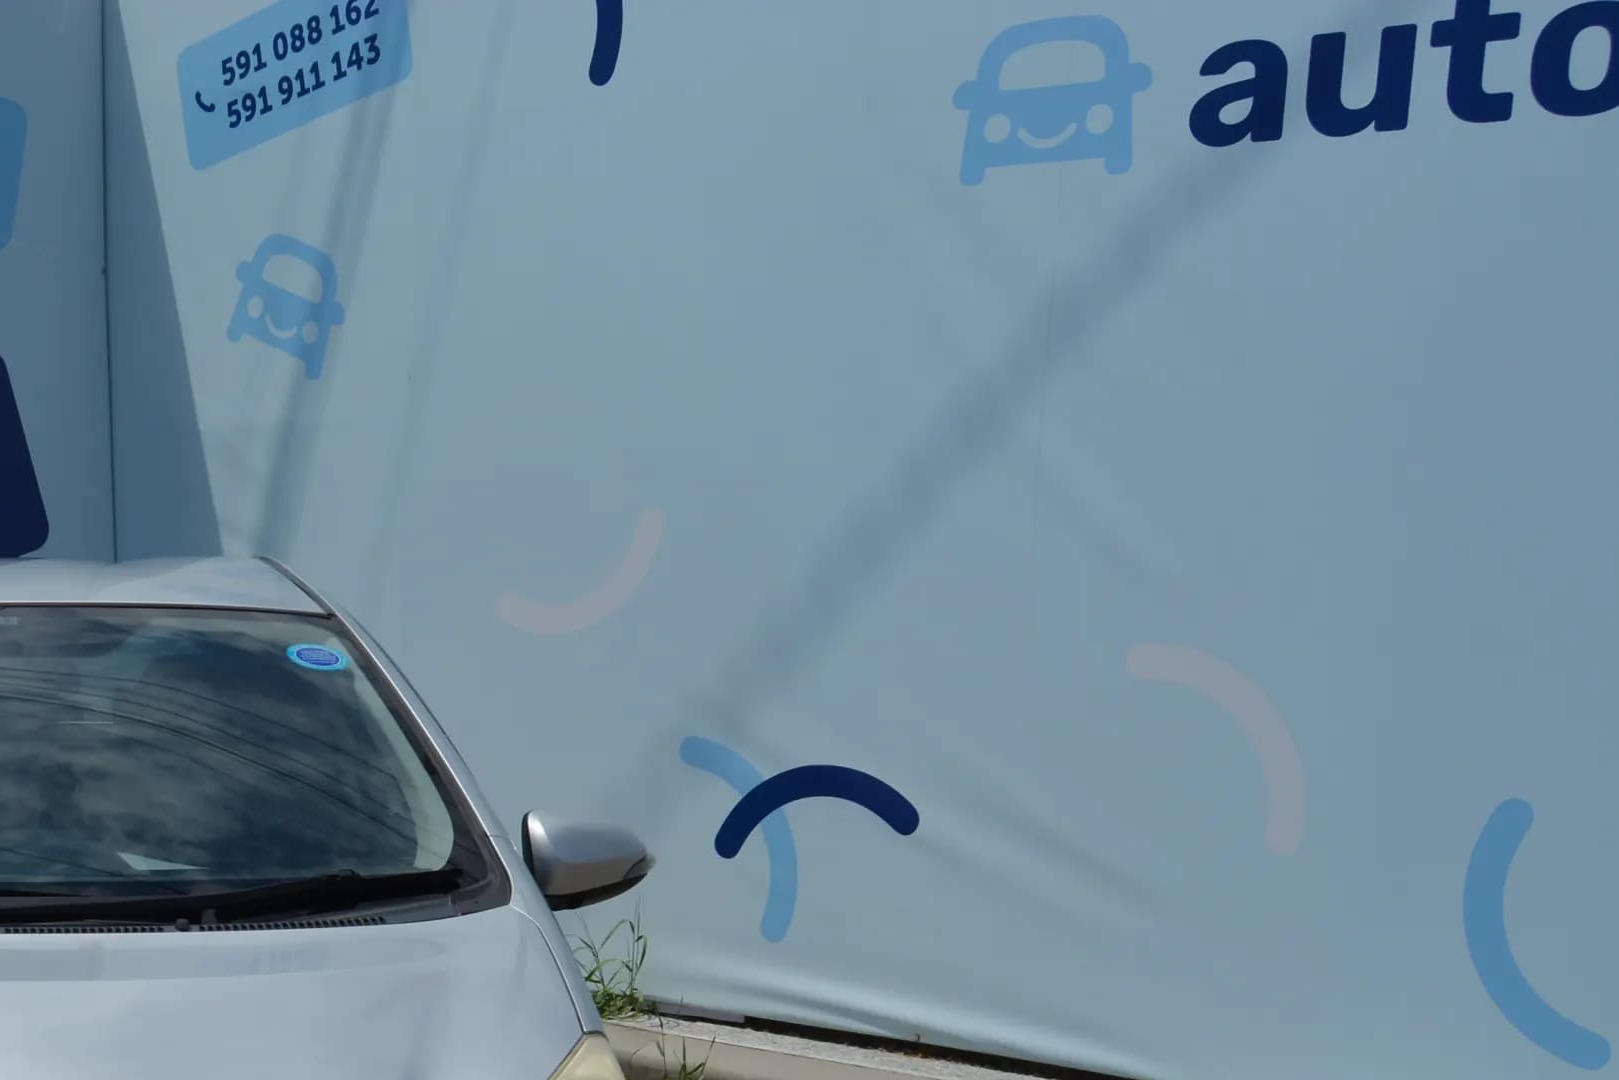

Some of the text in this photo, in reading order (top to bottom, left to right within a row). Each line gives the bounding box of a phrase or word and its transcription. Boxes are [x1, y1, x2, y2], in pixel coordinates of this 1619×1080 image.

[221, 0, 380, 86] 591 088 162
[227, 33, 381, 128] 591 911 143
[1189, 0, 1619, 147] auto
